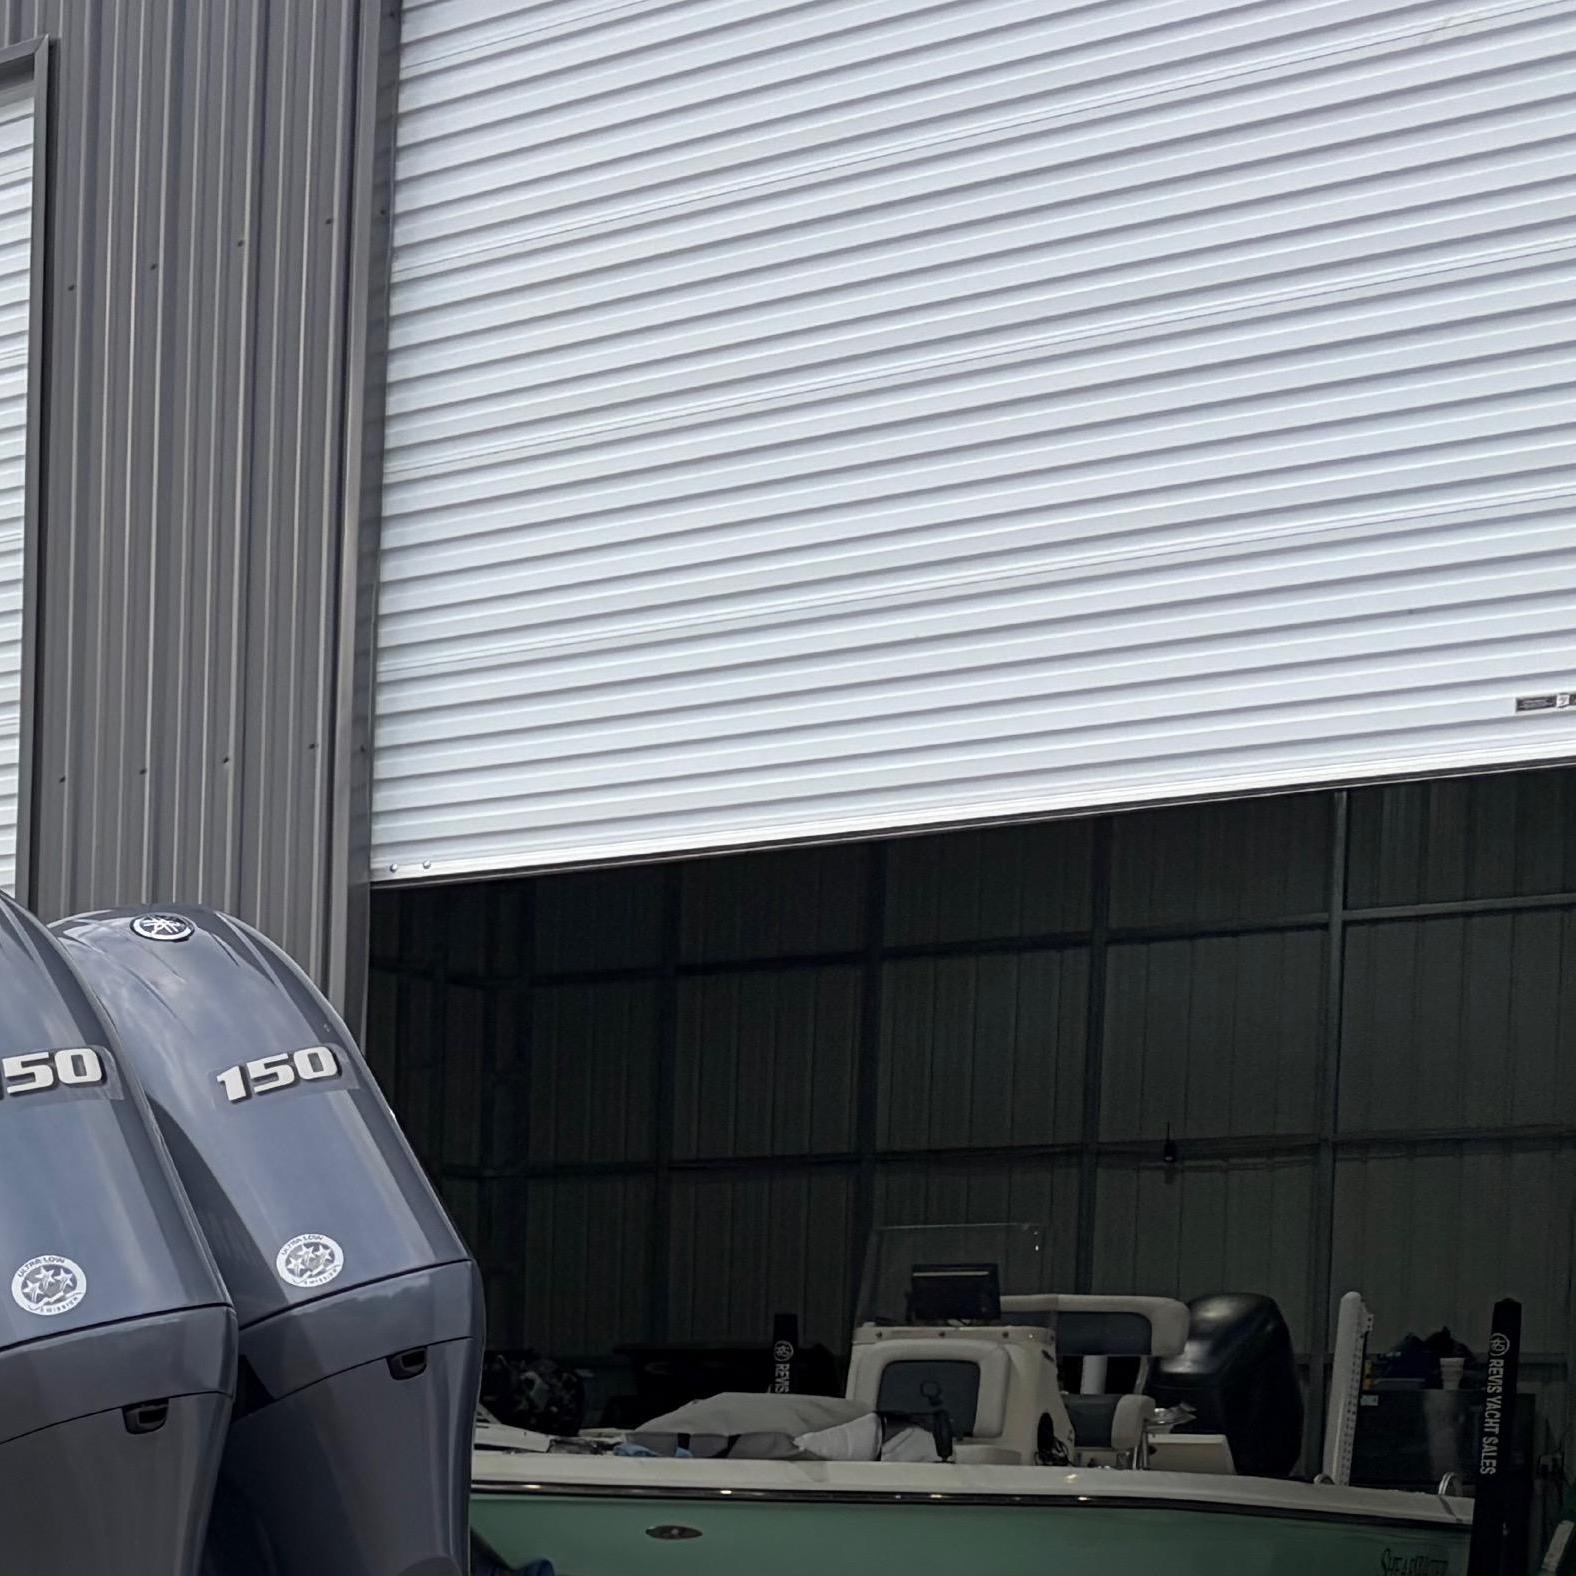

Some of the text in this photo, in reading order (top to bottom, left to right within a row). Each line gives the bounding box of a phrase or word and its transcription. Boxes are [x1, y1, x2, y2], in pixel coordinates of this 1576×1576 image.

[217, 1046, 339, 1101] 150
[17, 1256, 65, 1278] ULTRA LOW
[1480, 1359, 1505, 1475] REVIS YACHT SALES
